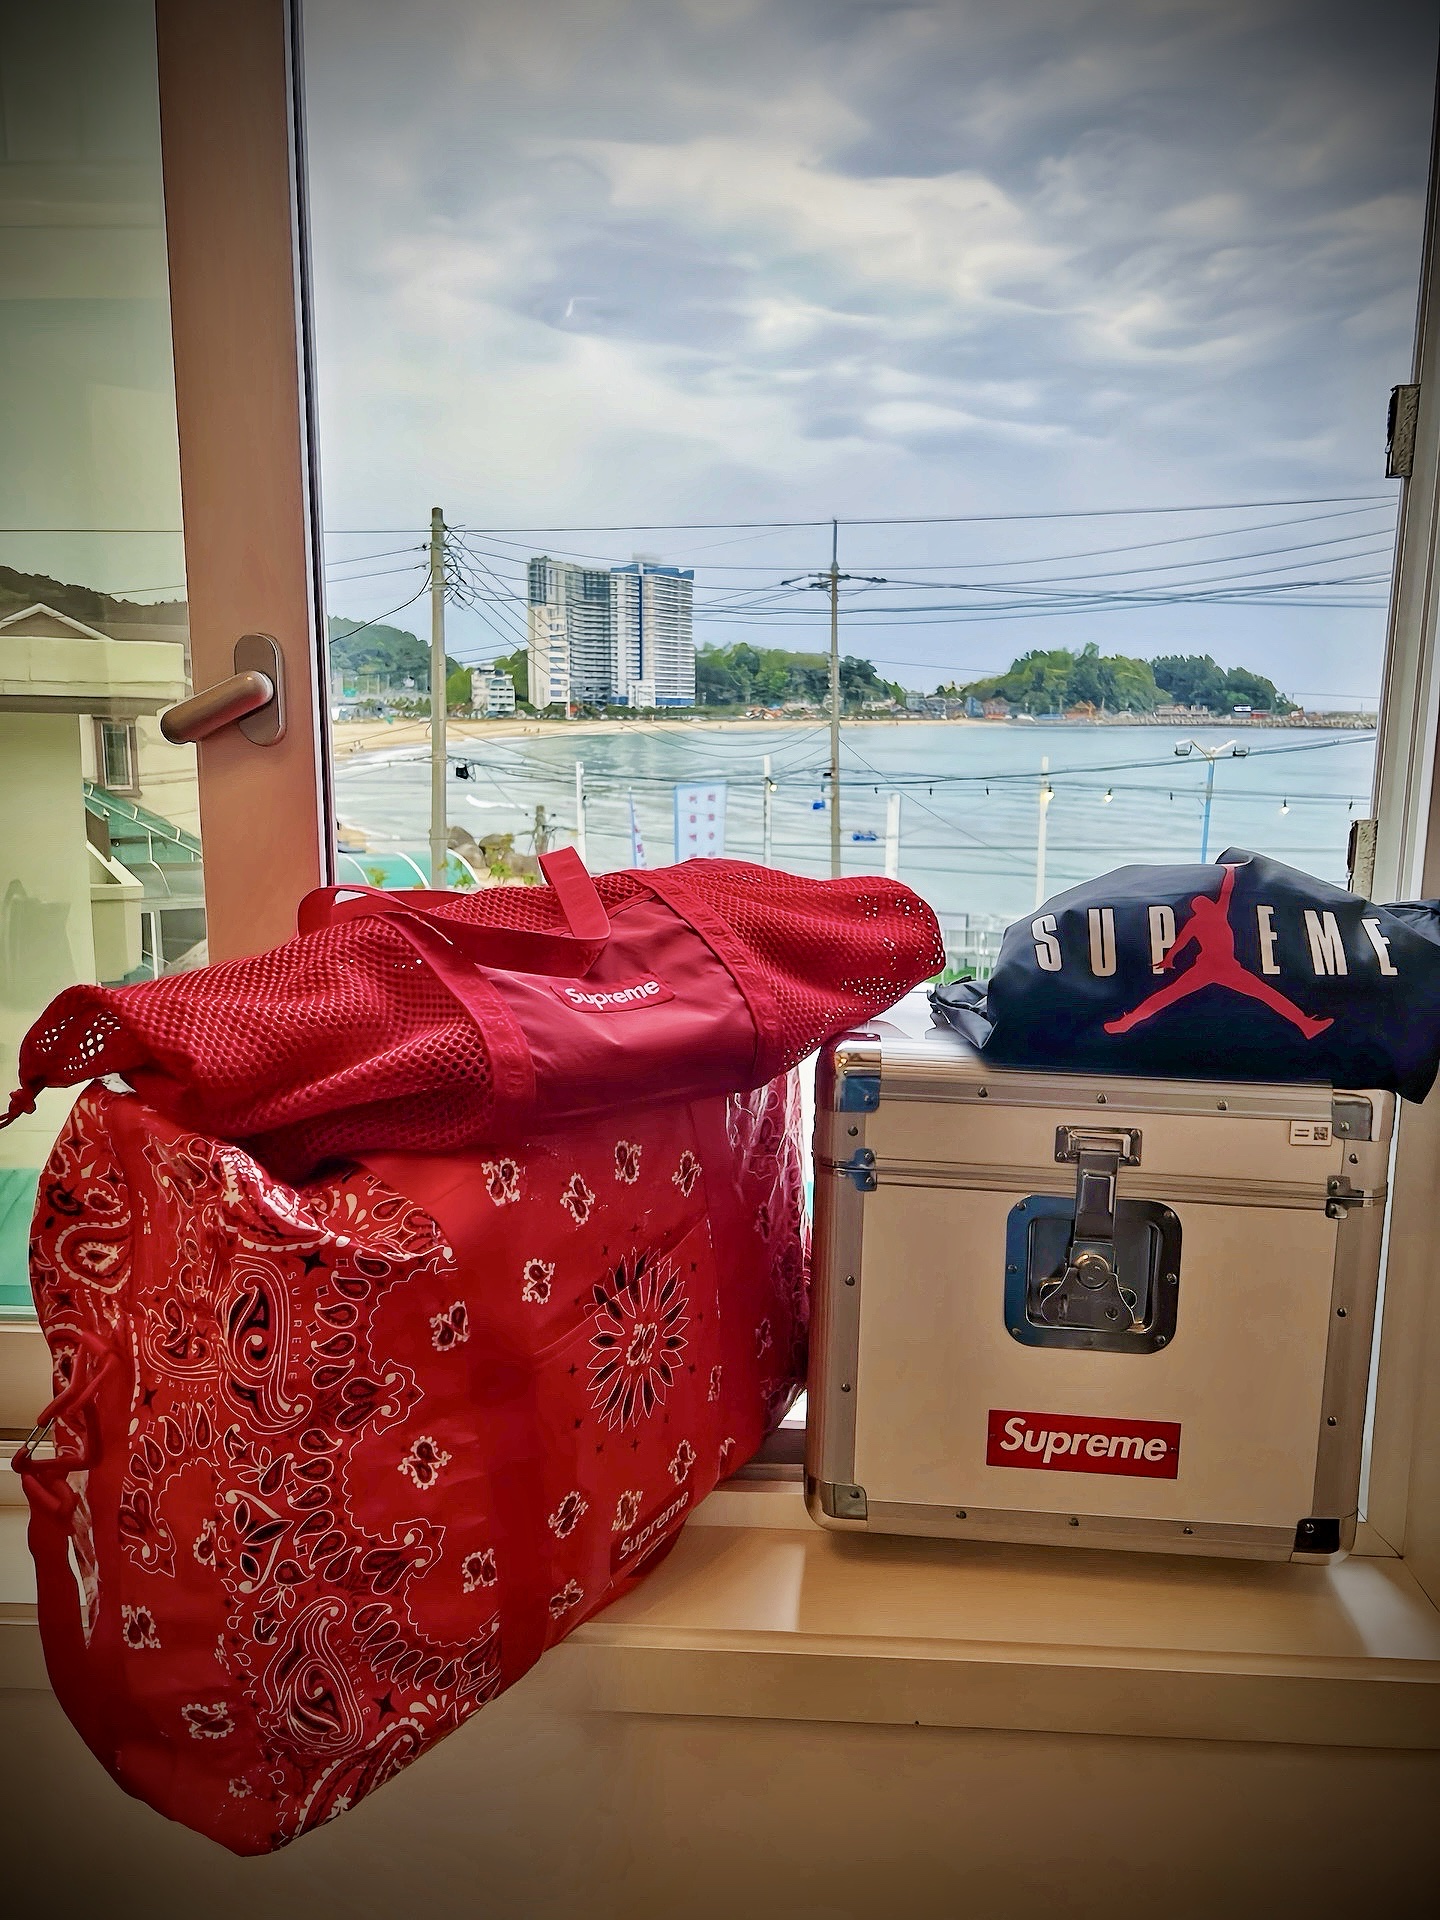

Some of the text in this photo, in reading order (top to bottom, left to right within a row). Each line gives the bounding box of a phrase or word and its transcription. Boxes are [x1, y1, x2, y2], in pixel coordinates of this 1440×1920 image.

[564, 980, 660, 1010] Supreme
[286, 1271, 303, 1380] SUPREME
[1000, 1417, 1168, 1464] Supreme
[619, 1491, 689, 1560] Supreme
